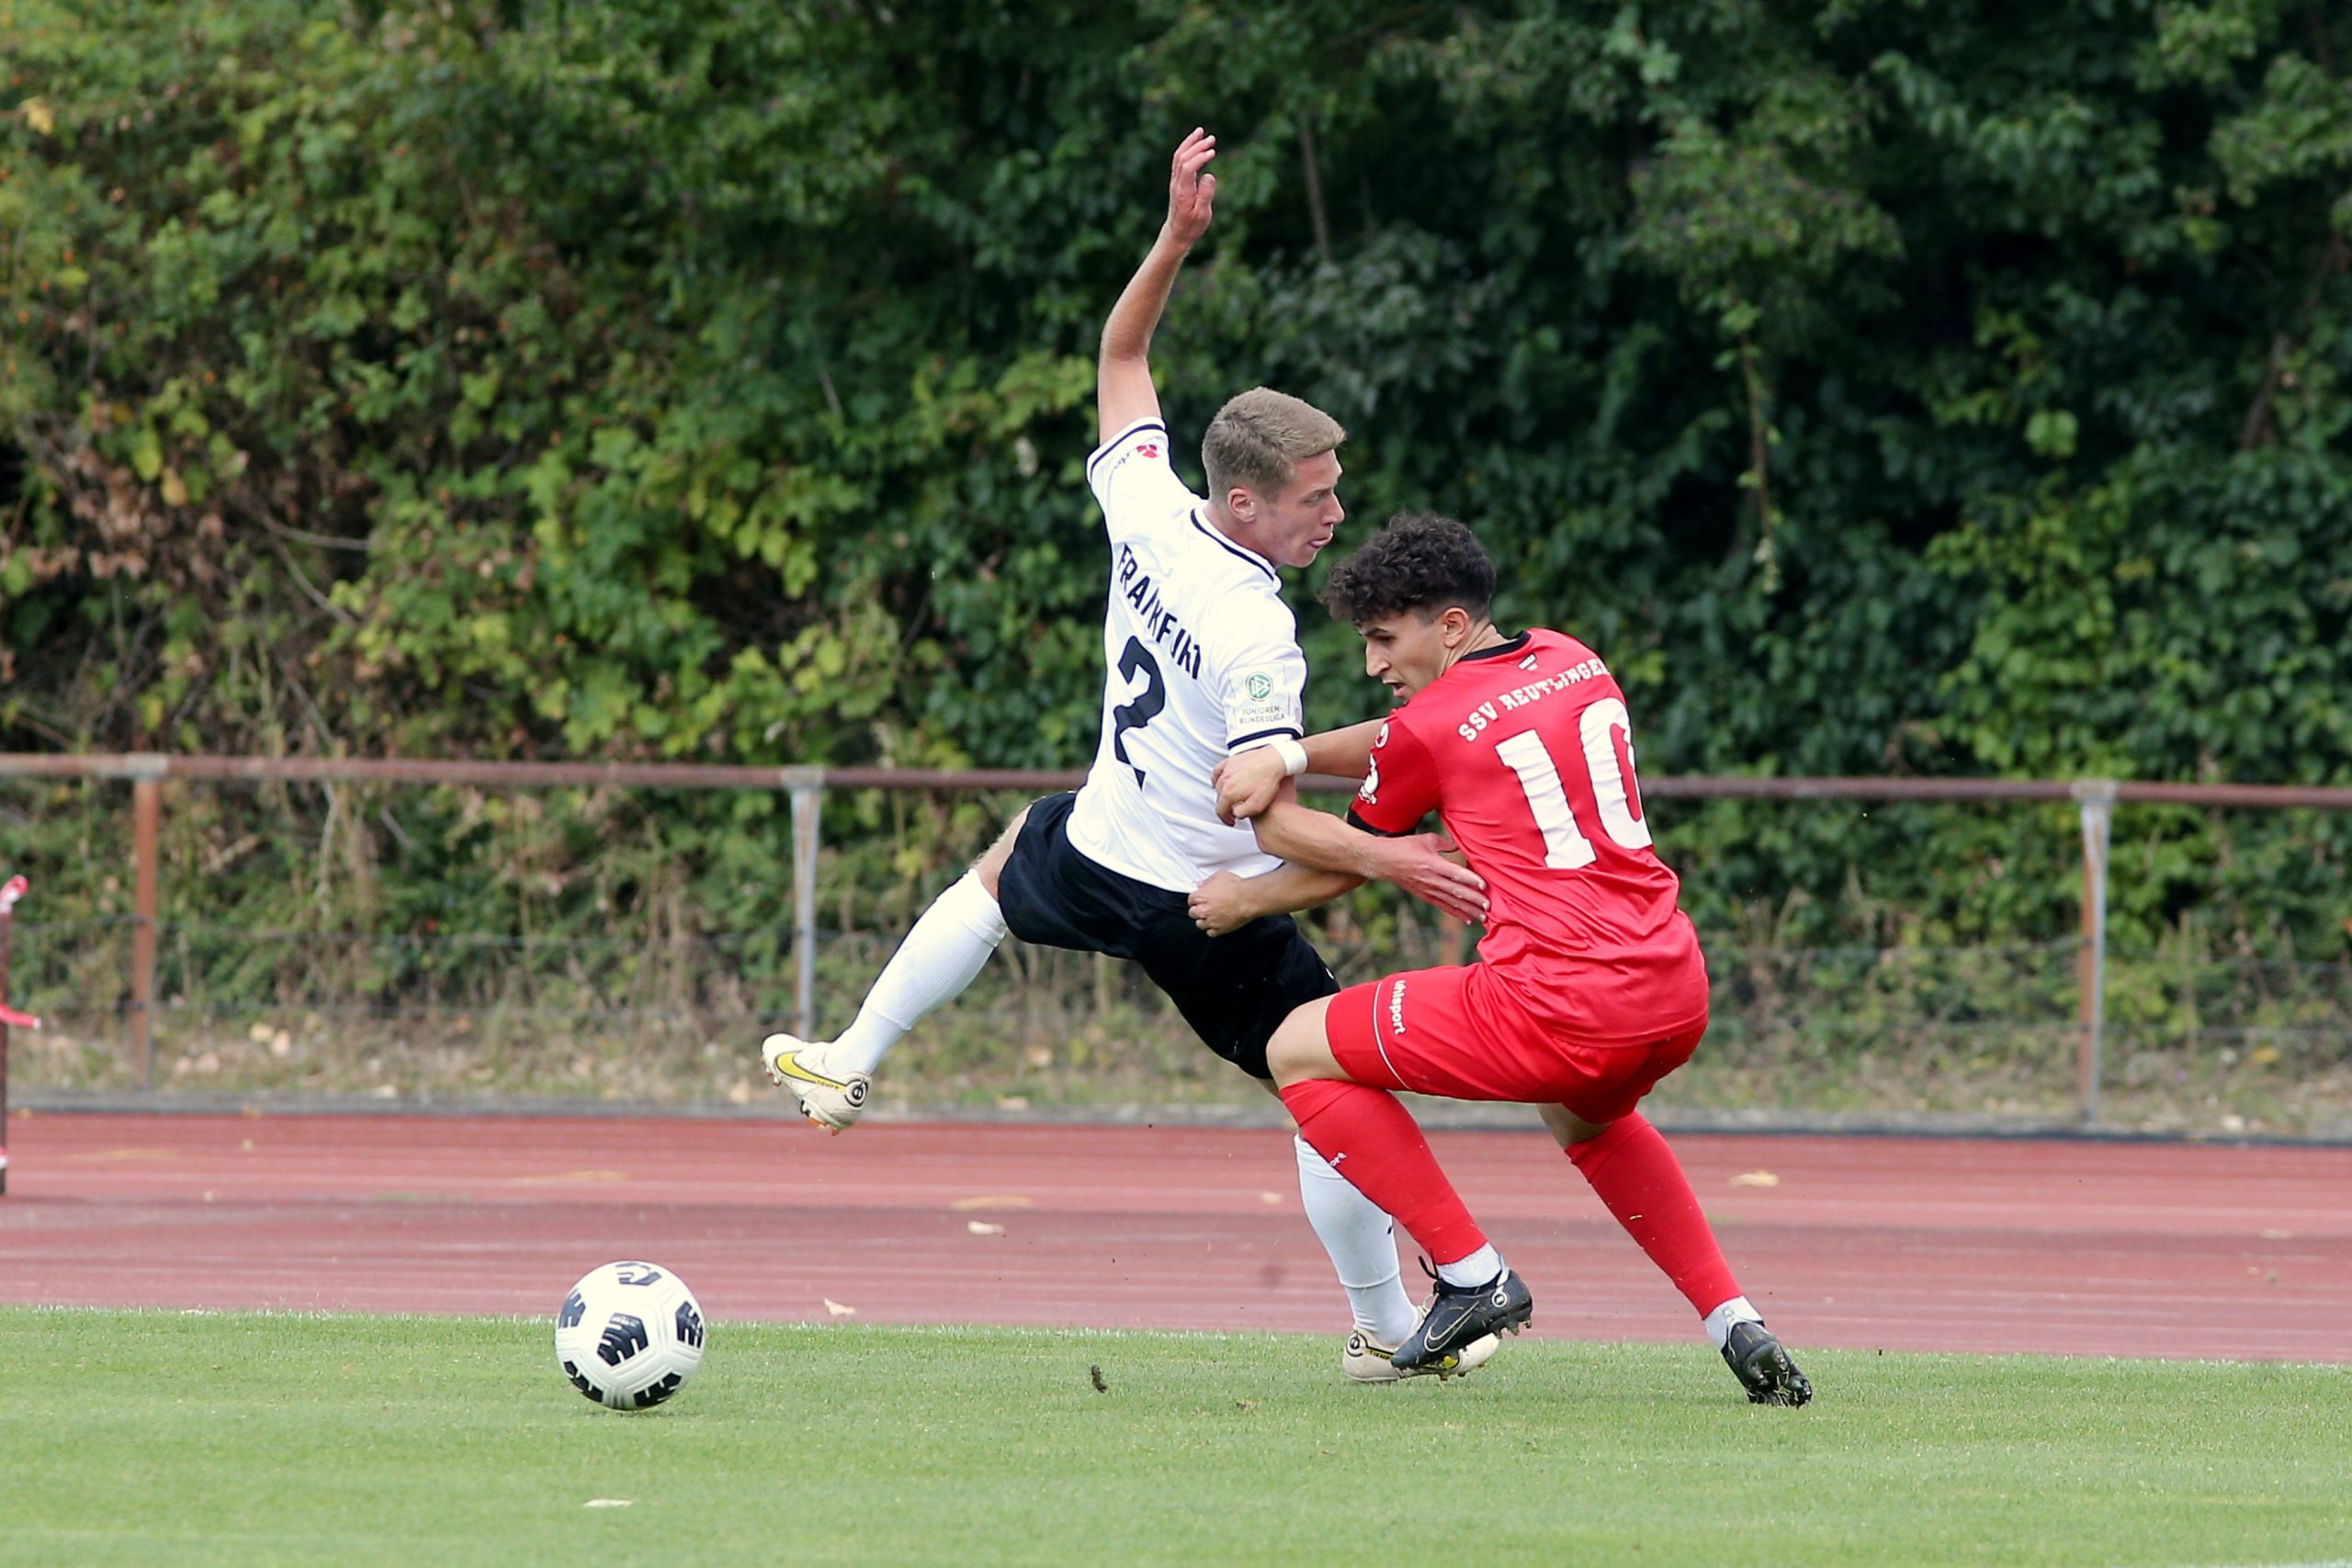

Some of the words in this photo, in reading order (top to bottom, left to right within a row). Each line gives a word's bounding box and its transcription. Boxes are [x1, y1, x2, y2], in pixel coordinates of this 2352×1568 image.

[1114, 635, 1166, 793] 2
[1457, 700, 1499, 742] SSV
[1494, 696, 1654, 870] 10
[1388, 979, 1407, 1035] uhlsport
